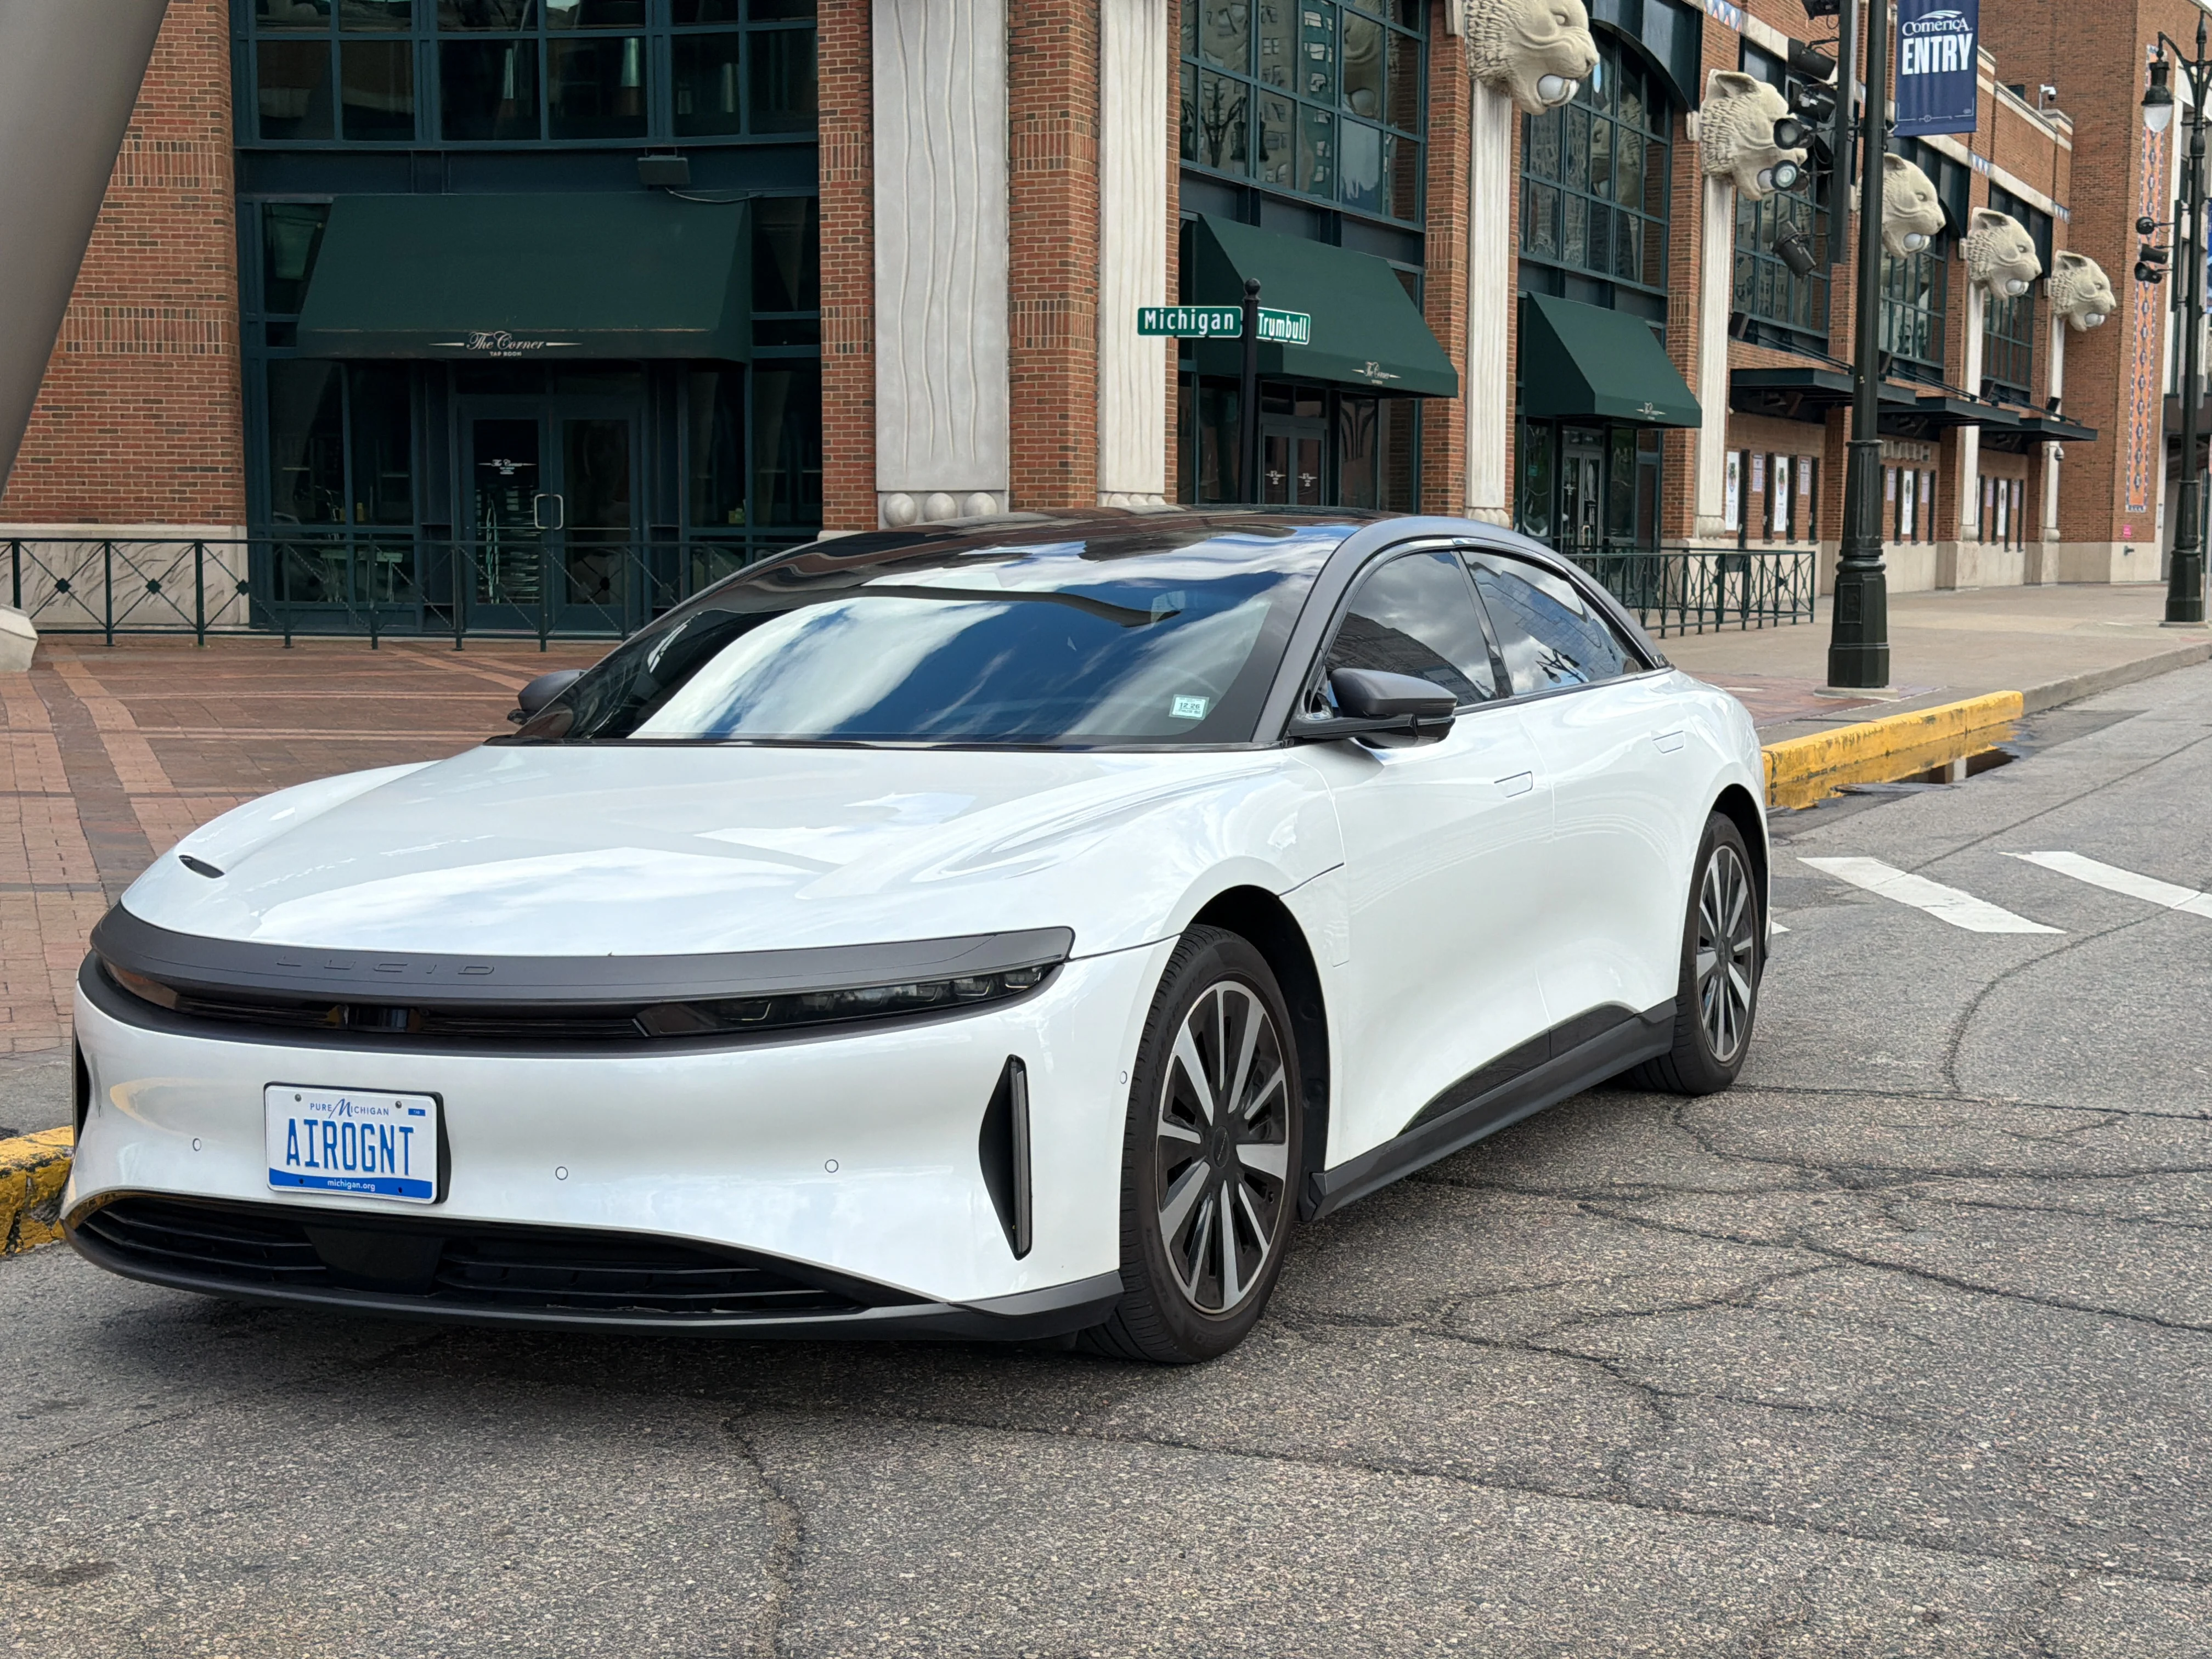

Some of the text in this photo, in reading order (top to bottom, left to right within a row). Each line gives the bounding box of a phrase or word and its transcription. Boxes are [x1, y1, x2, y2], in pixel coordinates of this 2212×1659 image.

[1902, 33, 1973, 75] ENTRY
[1144, 308, 1234, 335] Michigan
[1258, 313, 1307, 341] Trumbull
[466, 331, 545, 350] The Corner
[276, 955, 495, 975] LUCID
[310, 1098, 390, 1119] PURE MICHIGAN
[327, 1178, 376, 1192] michigan.org
